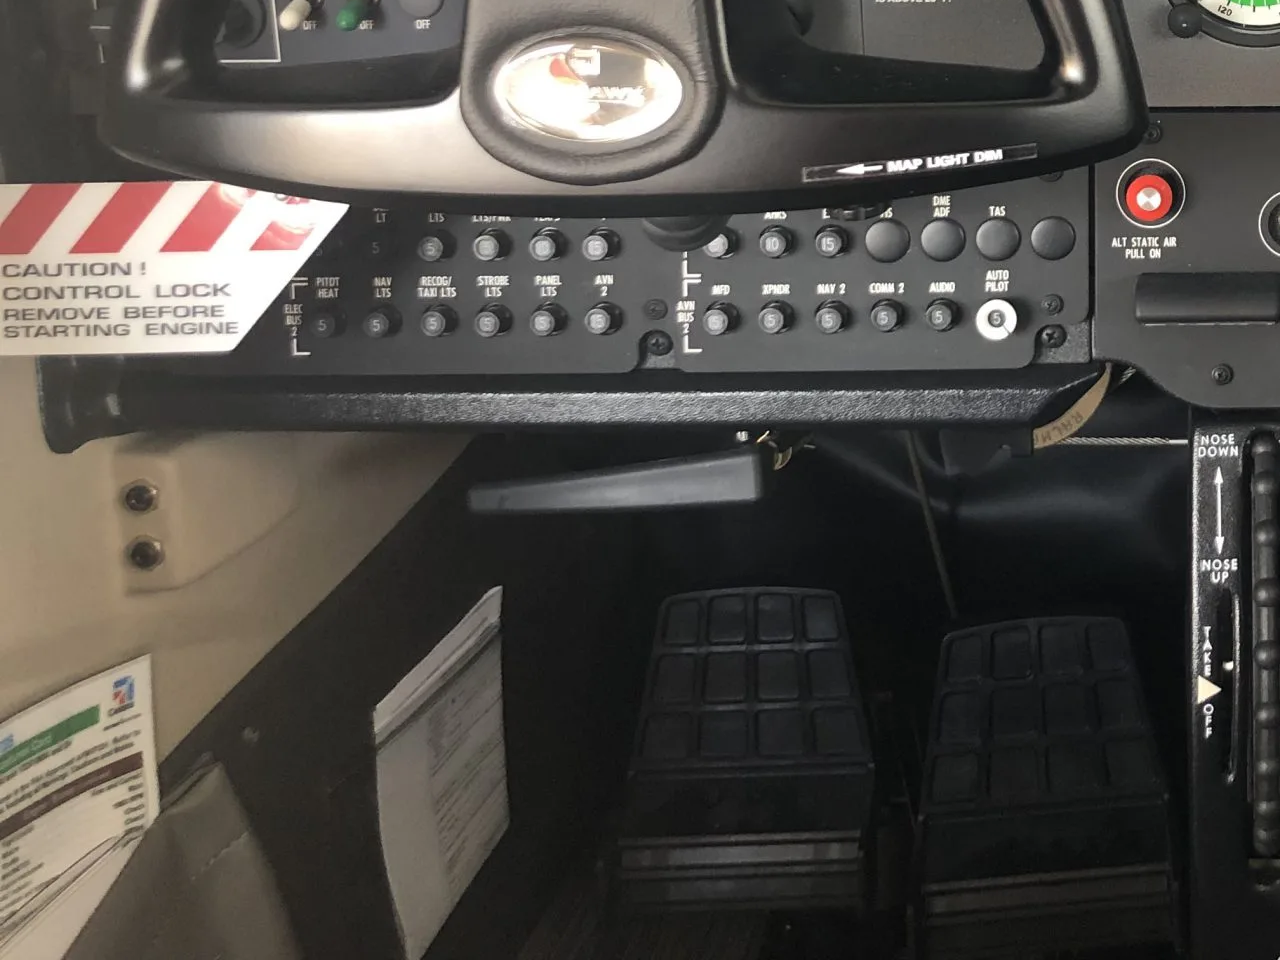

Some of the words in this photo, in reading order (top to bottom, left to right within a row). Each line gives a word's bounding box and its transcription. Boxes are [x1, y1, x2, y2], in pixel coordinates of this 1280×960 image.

[887, 158, 923, 172] MAP
[926, 153, 970, 168] LIGHT
[974, 149, 1002, 163] DIM
[933, 196, 950, 206] DME
[934, 207, 950, 217] ADF
[990, 206, 1005, 216] TAS
[1112, 237, 1127, 247] ALT
[1132, 237, 1159, 247] STATIC
[1164, 237, 1176, 247] AIR
[1125, 249, 1145, 259] PULL
[1150, 249, 1160, 258] ON
[986, 270, 1009, 280] AUTO
[422, 276, 451, 286] RECOG/
[929, 282, 955, 292] AUDIO
[986, 281, 1009, 292] PILOT
[2, 285, 141, 301] CONTROL
[155, 284, 230, 298] LOCK
[418, 288, 437, 297] TAXI
[441, 287, 456, 297] LTS
[3, 308, 110, 321] REMOVE
[123, 305, 223, 319] BEFORE
[4, 324, 129, 338] STARTING
[145, 322, 238, 335] ENGINE
[1201, 434, 1234, 445] NOSE
[1199, 447, 1238, 457] DOWN
[1200, 559, 1237, 571] NOSE
[1211, 571, 1228, 583] UP
